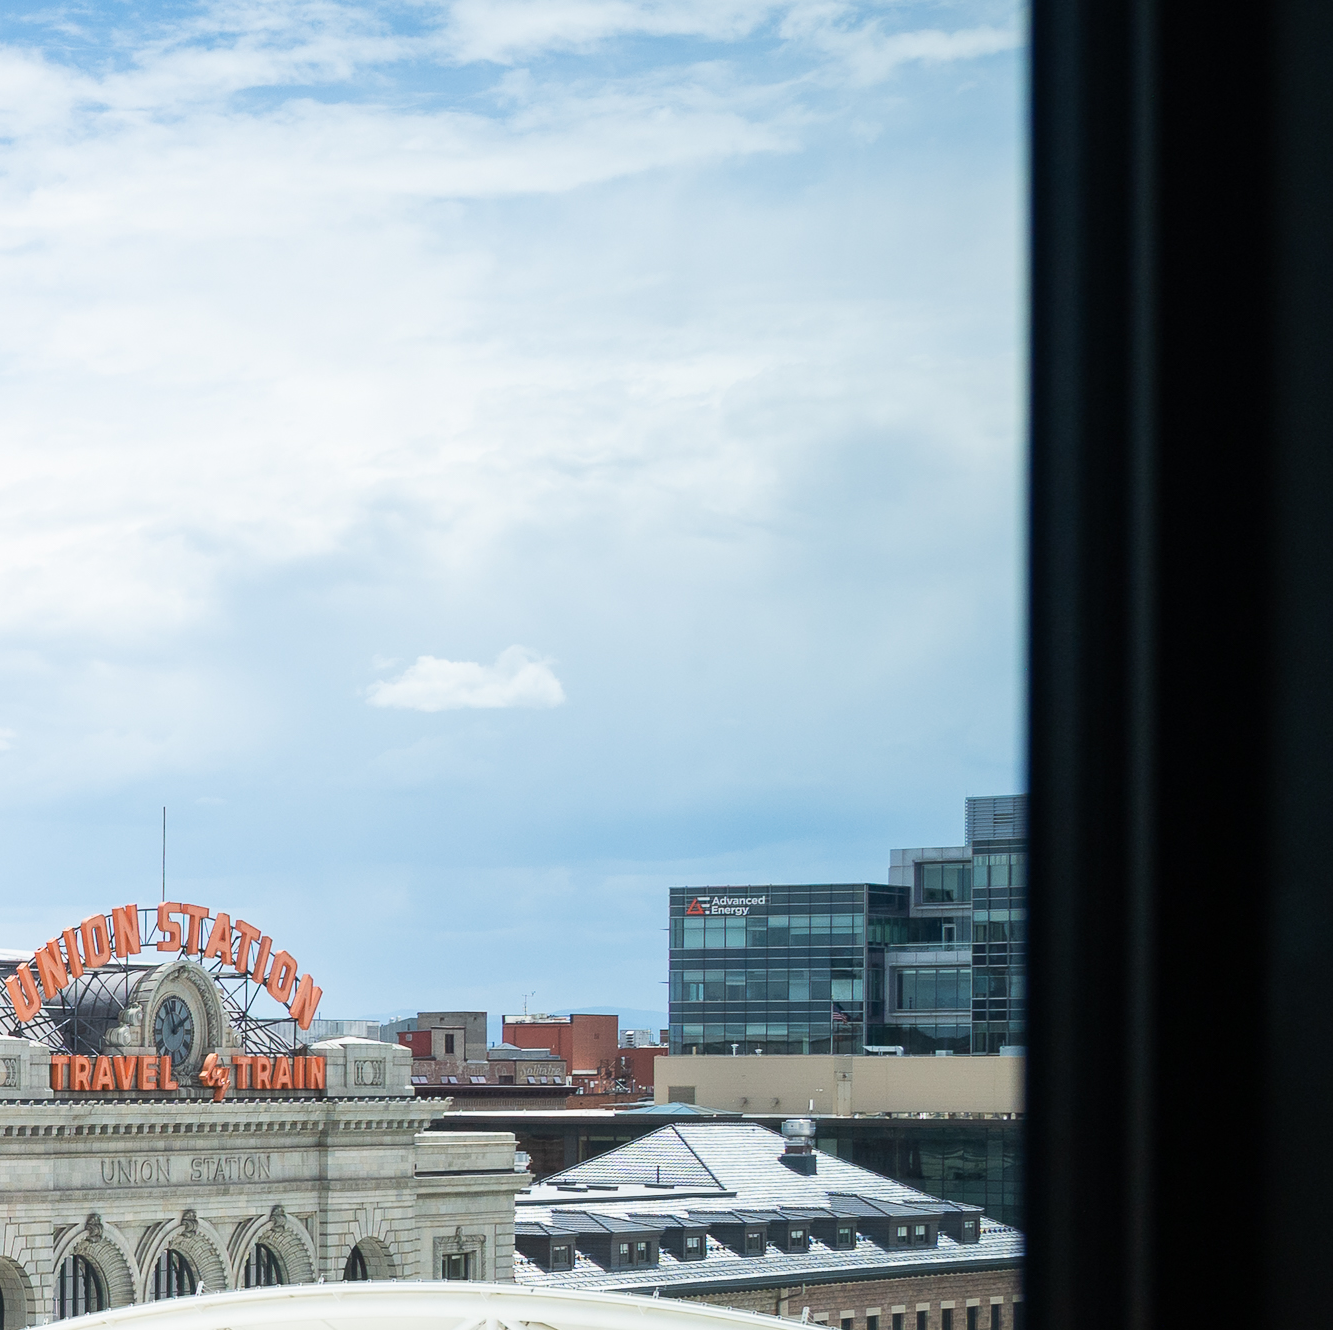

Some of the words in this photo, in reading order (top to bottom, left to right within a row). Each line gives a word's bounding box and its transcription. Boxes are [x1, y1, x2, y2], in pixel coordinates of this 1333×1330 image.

[711, 895, 766, 905] Advanced
[711, 905, 750, 916] Energy
[5, 903, 141, 1023] UNION
[157, 901, 323, 1031] STATION
[50, 1054, 179, 1091] TRAVEL
[199, 1052, 231, 1102] by
[232, 1055, 326, 1091] TRAIN
[101, 1158, 171, 1185] UNION
[190, 1155, 271, 1182] STATION
